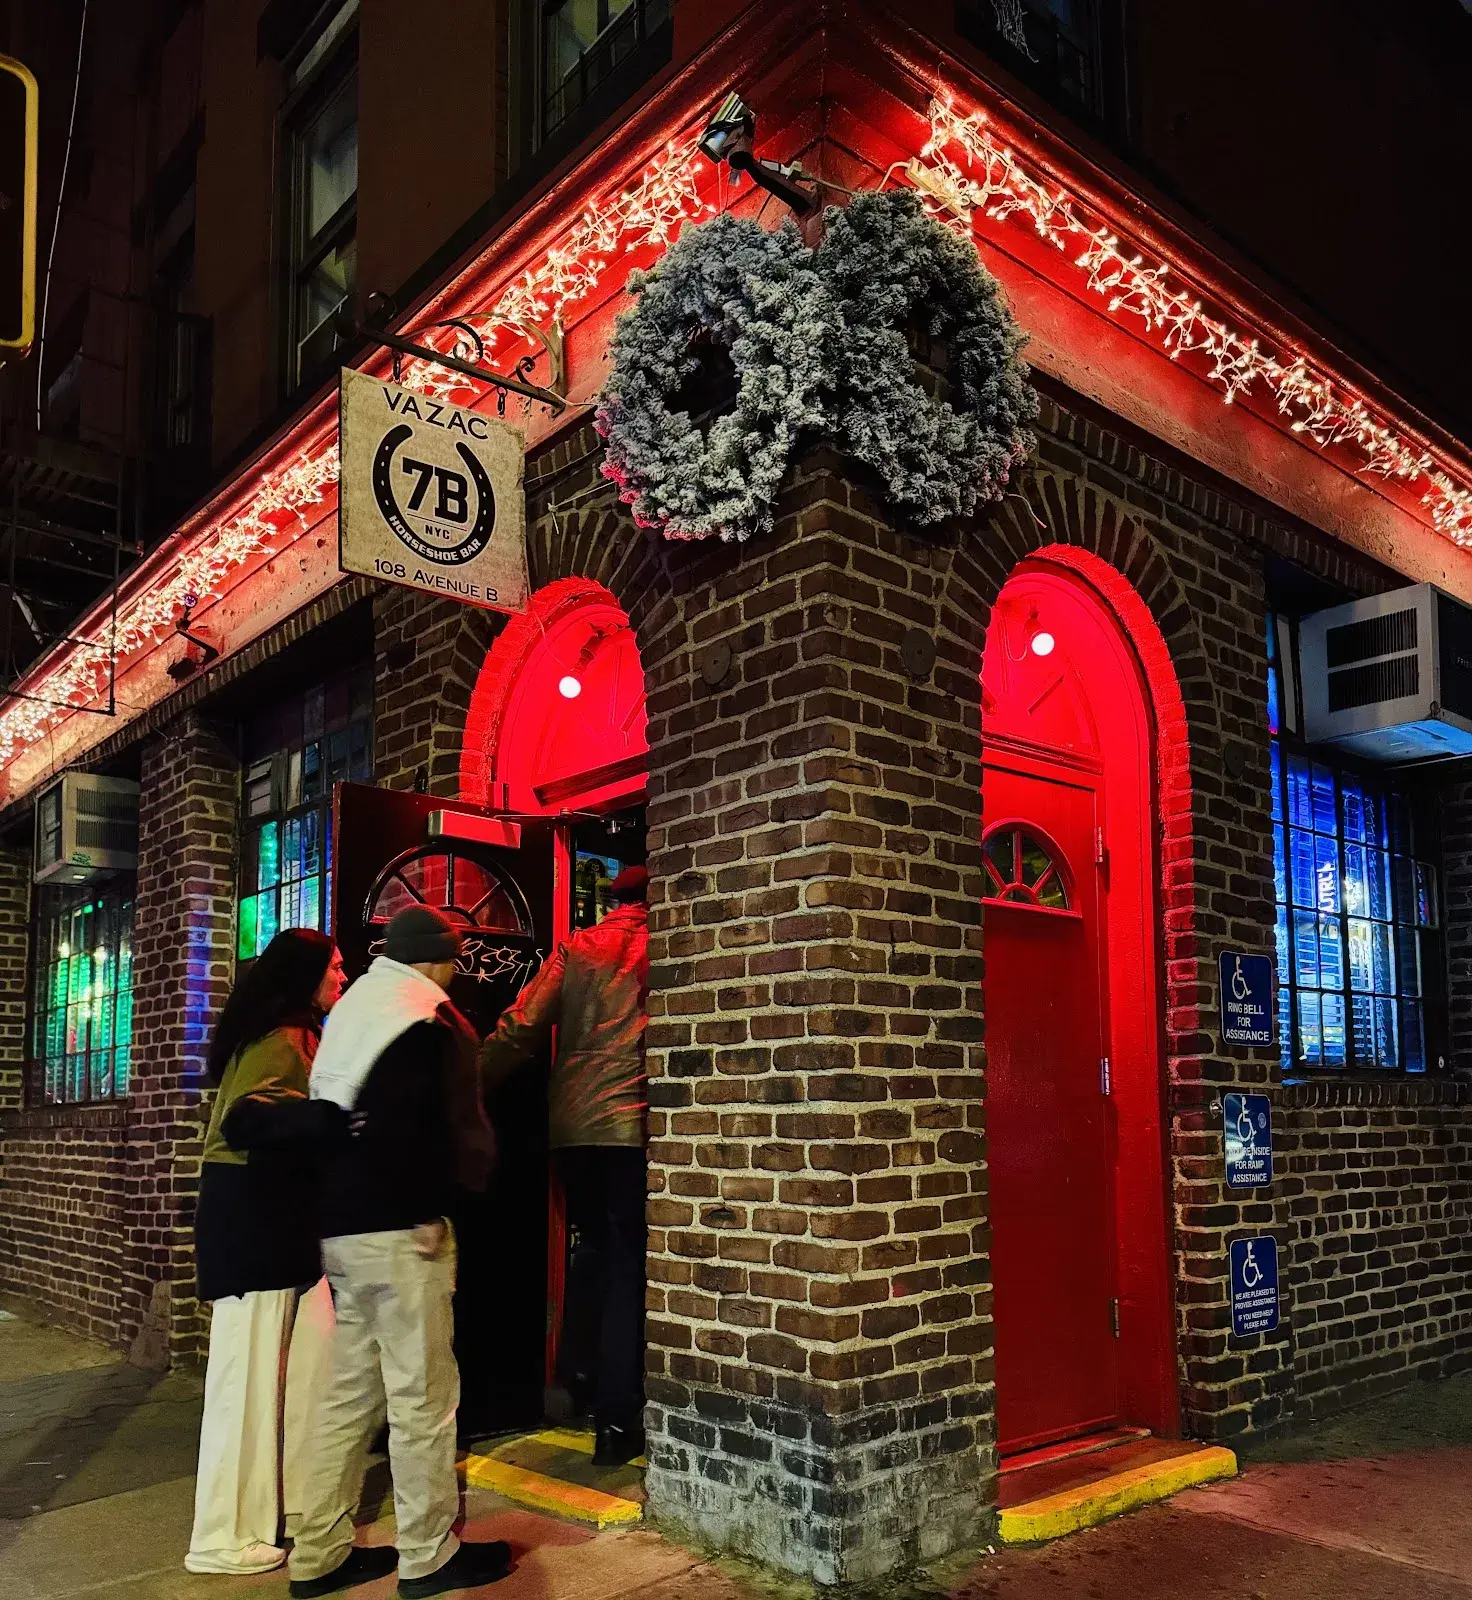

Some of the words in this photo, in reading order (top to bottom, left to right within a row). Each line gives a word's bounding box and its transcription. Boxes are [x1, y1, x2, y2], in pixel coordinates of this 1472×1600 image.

[383, 387, 489, 440] VAZAC
[402, 457, 468, 524] 7B
[389, 515, 459, 561] HORSESHOE
[460, 538, 482, 558] BAR
[425, 524, 450, 540] NYC
[374, 558, 407, 578] 108
[413, 569, 481, 598] AVENUE
[486, 588, 499, 602] B
[1228, 1002, 1242, 1013] RING
[1243, 1003, 1264, 1015] BELL
[1237, 1016, 1251, 1027] FOR
[1226, 1029, 1269, 1041] ASSISTANCE
[1235, 1161, 1247, 1170] FOR
[1247, 1160, 1264, 1169] RAMP
[1232, 1173, 1267, 1183] ASSISTANCE
[1242, 1291, 1250, 1299] ARE
[1251, 1289, 1269, 1297] PLEASED
[1235, 1301, 1252, 1310] PROVIDE
[1253, 1297, 1276, 1306] ASSISTANCE
[1252, 1311, 1263, 1319] NEED
[1263, 1309, 1273, 1317] HELP
[1244, 1321, 1260, 1329] PLEASE
